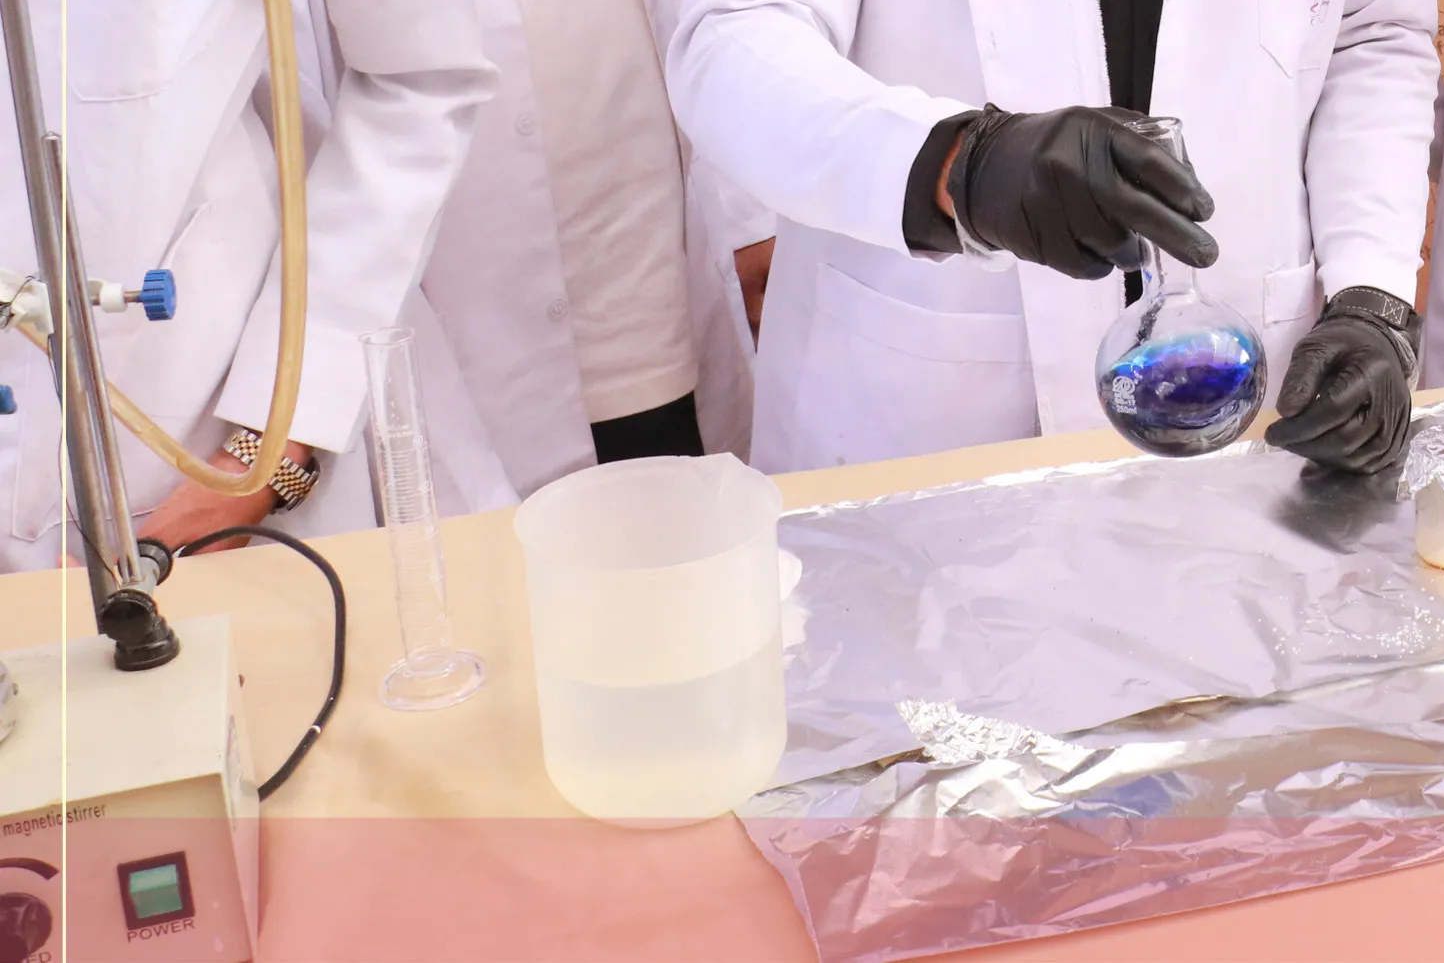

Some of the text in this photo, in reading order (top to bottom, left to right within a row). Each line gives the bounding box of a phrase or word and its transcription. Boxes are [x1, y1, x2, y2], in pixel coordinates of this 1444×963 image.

[2, 803, 107, 837] magnetic stirrer
[126, 918, 196, 943] POWER
